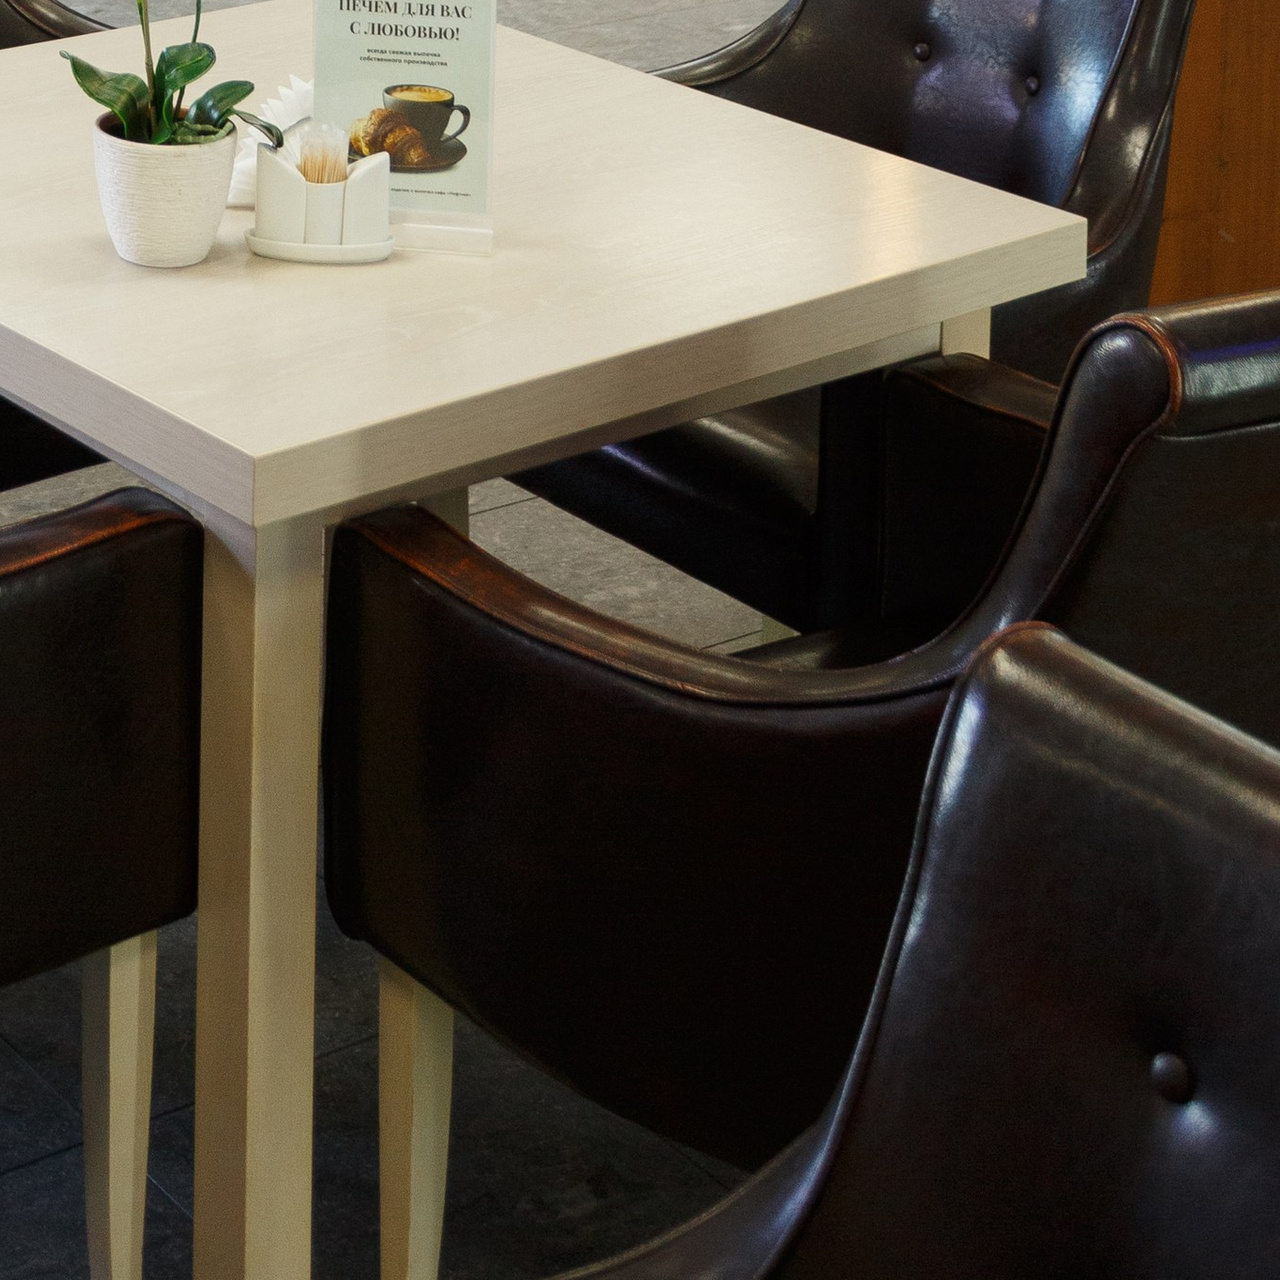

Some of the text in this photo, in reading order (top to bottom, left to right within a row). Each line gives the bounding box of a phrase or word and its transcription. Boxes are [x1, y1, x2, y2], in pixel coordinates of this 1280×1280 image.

[401, 2, 435, 18] ДЛЯ
[440, 4, 472, 19] ВАС
[349, 21, 460, 41] С ЛЮБОВЬЮ!
[359, 55, 448, 67] собственного производства
